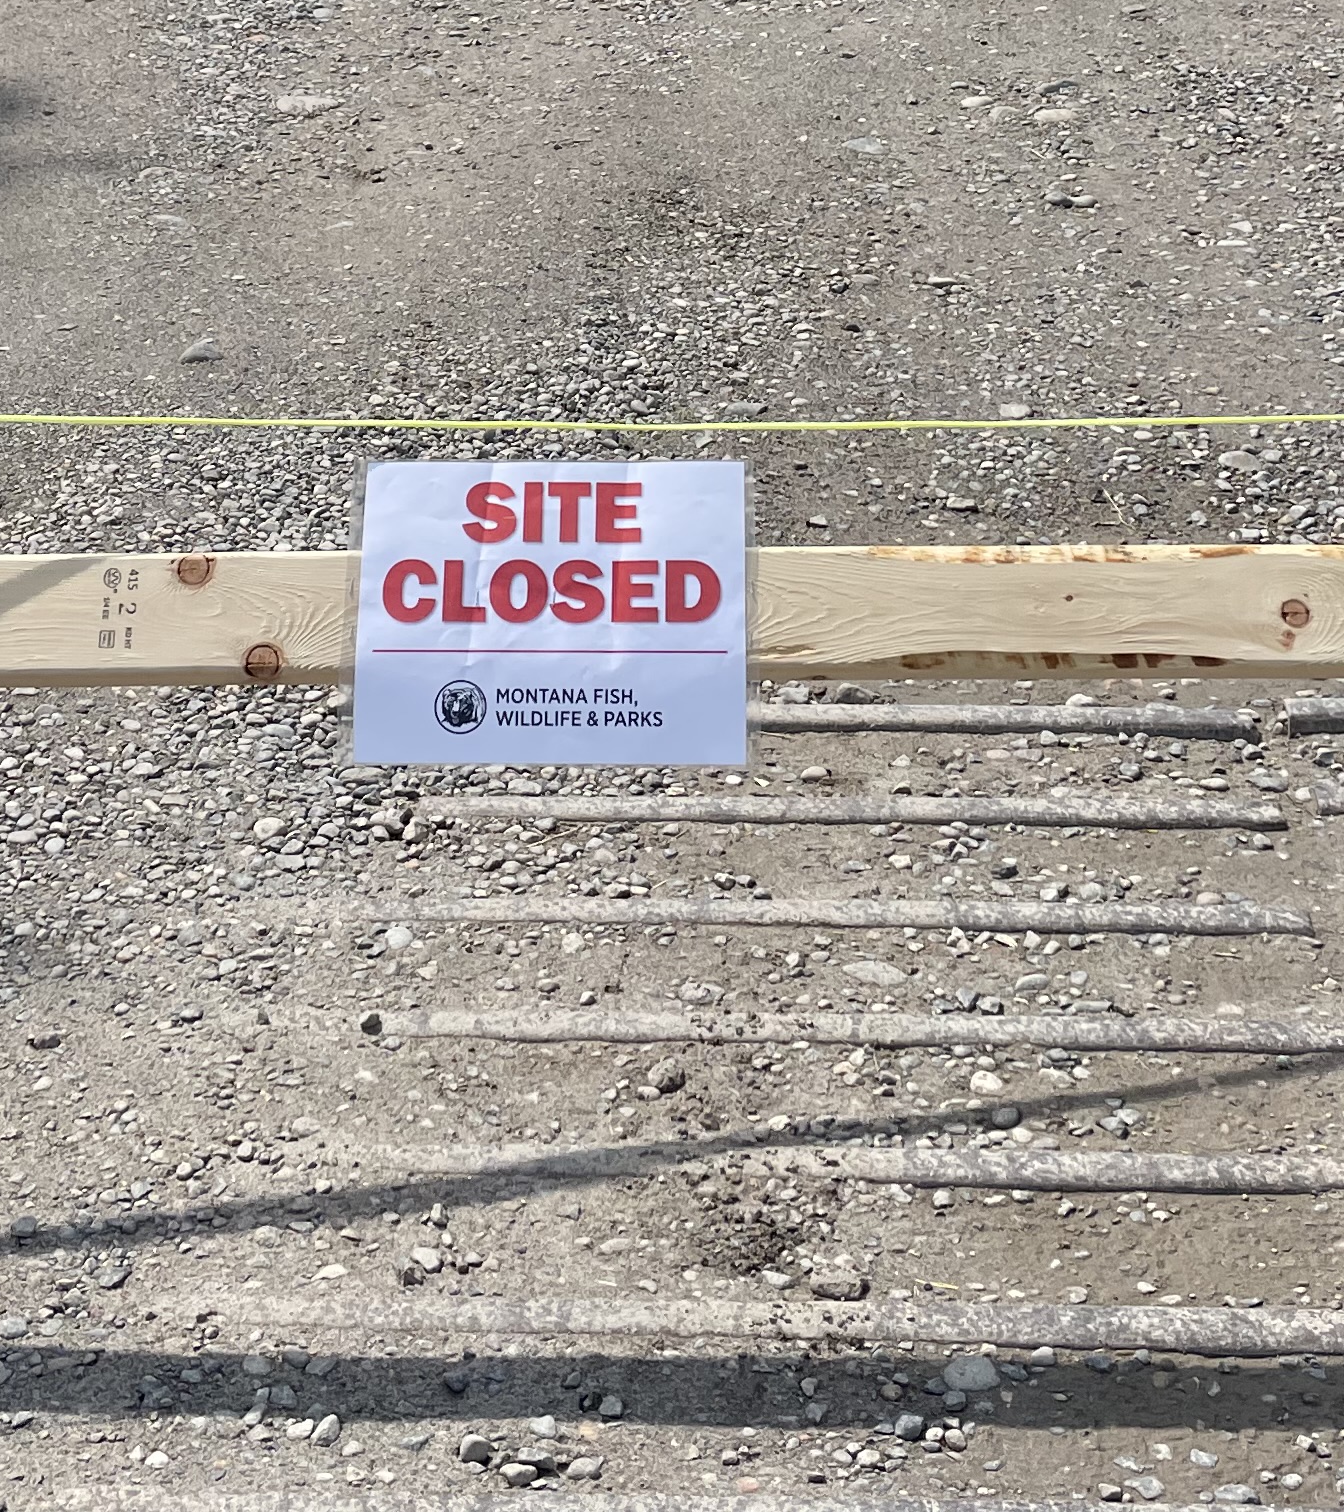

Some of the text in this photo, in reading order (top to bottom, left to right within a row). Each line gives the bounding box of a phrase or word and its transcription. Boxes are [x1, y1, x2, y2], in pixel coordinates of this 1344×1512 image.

[462, 481, 642, 543] SITE
[127, 568, 140, 591] 415
[382, 559, 721, 624] CLOSED
[118, 602, 137, 615] 2
[496, 688, 639, 707] MONTANA FISH,
[495, 711, 664, 727] WILDLIFE & PARKS
